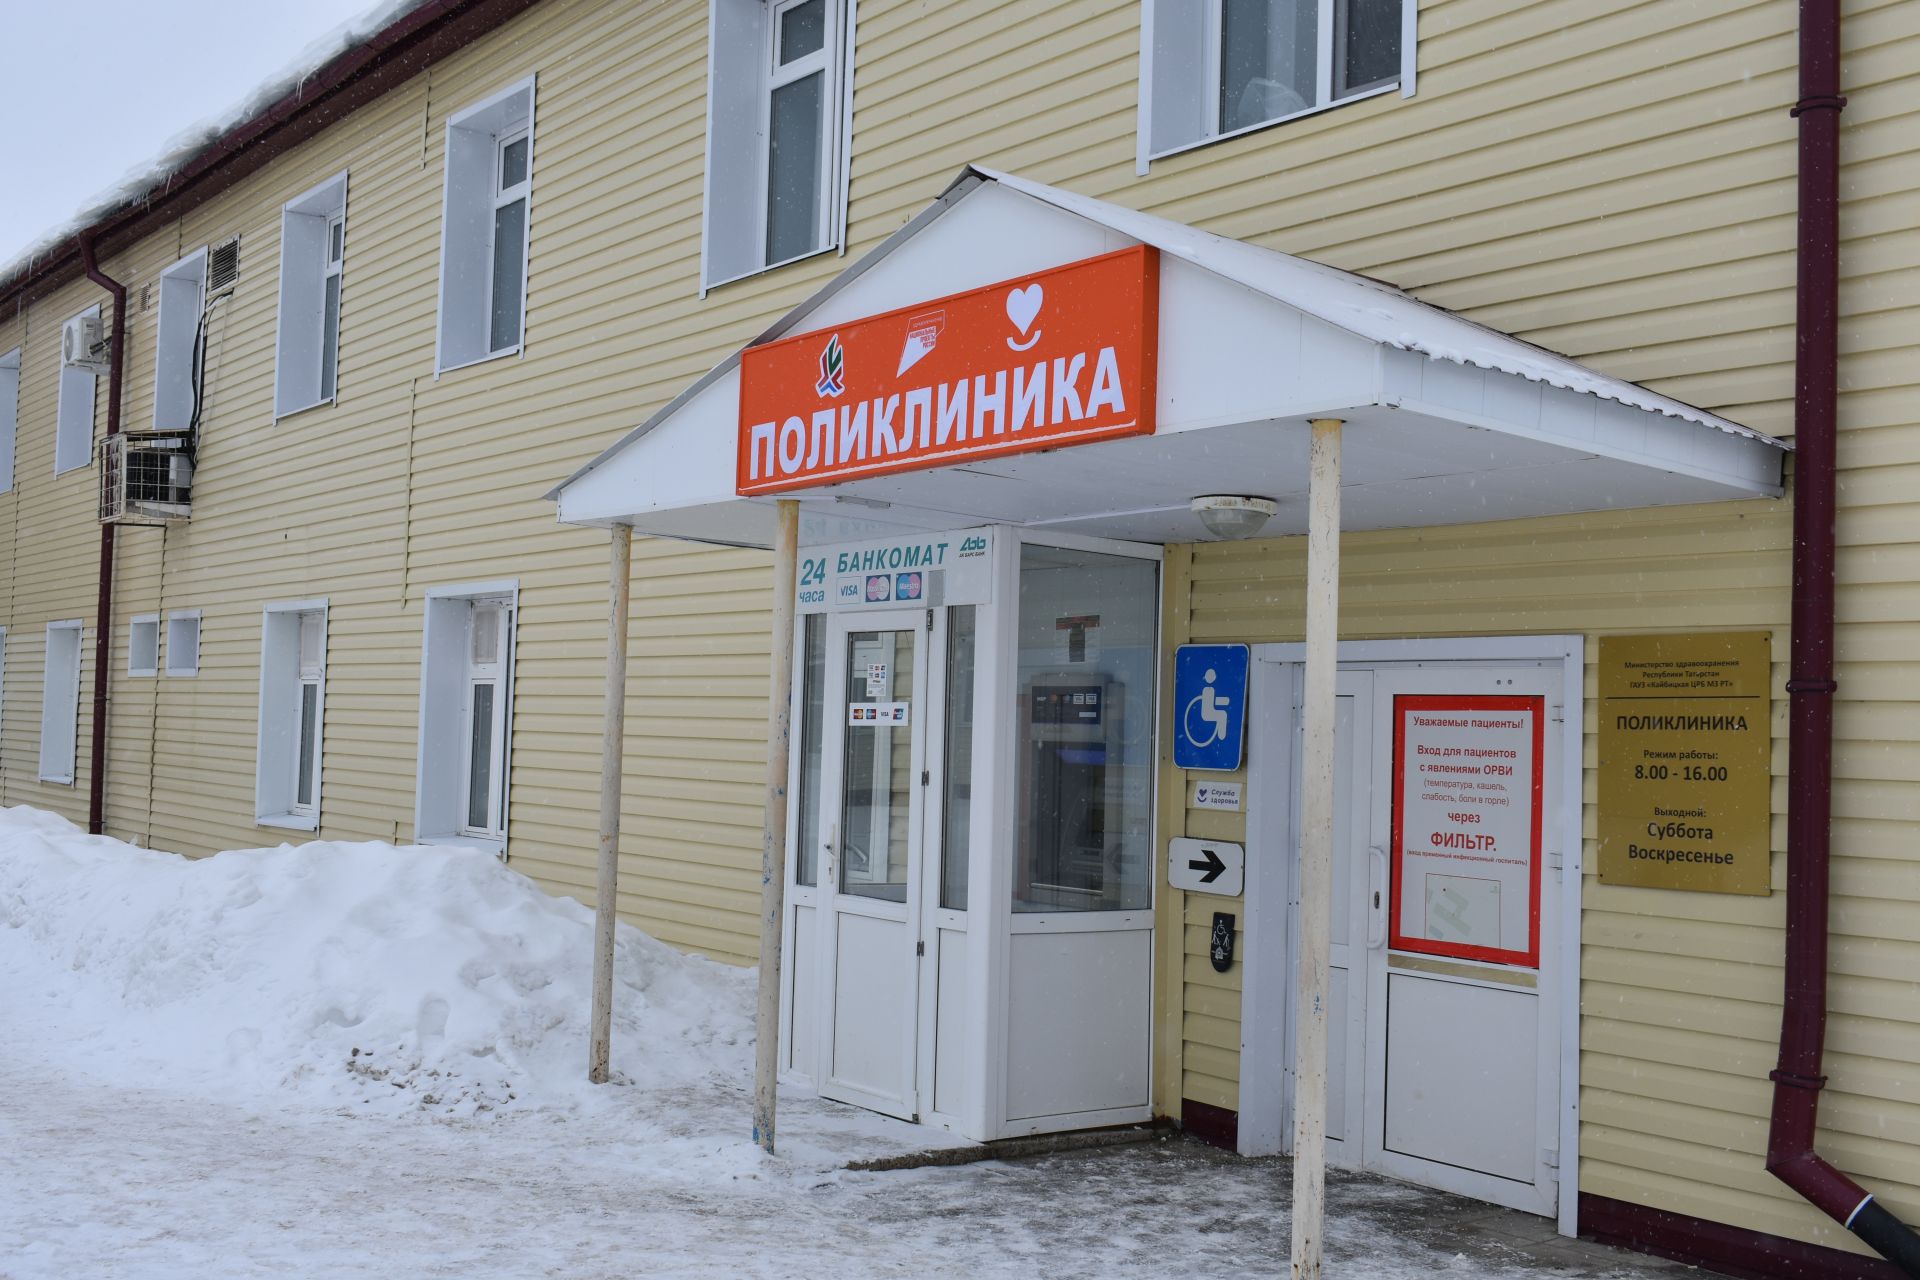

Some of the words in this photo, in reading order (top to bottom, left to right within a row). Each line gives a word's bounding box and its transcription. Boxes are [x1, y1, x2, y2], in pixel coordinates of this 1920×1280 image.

[749, 346, 1126, 480] ПОЛИКЛИНИКА
[836, 543, 949, 573] БАНКОМАТ
[800, 557, 826, 585] 24
[800, 590, 825, 603] часа
[841, 584, 858, 597] VISA
[1624, 661, 1674, 669] Министерство
[1676, 660, 1739, 669] здравоохранения
[1642, 670, 1684, 679] Республики
[1691, 680, 1705, 688] ЦРБ
[1413, 716, 1469, 728] Уважаемые
[1471, 718, 1524, 730] пациенты!
[1616, 715, 1748, 730] ПОЛИКЛИНИКА
[1417, 745, 1441, 757] Вход
[1443, 748, 1461, 757] для
[1464, 748, 1517, 759] пациентов
[1643, 749, 1677, 759] Режим
[1679, 749, 1719, 760] работы:
[1427, 764, 1481, 774] явлениями
[1483, 764, 1513, 776] ОРВИ
[1634, 764, 1668, 780] 8.00
[1683, 766, 1728, 781] 16.00
[1424, 778, 1475, 790] (температура,
[1477, 783, 1507, 792] кашель,
[1422, 793, 1457, 803] слабость,
[1459, 794, 1477, 803] боли
[1485, 797, 1510, 807] горле)
[1448, 812, 1481, 824] через
[1654, 807, 1707, 818] Выходной:
[1647, 822, 1713, 840] Суббота
[1430, 831, 1497, 852] ФИЛЬТР.
[1628, 844, 1734, 864] Воскресенье
